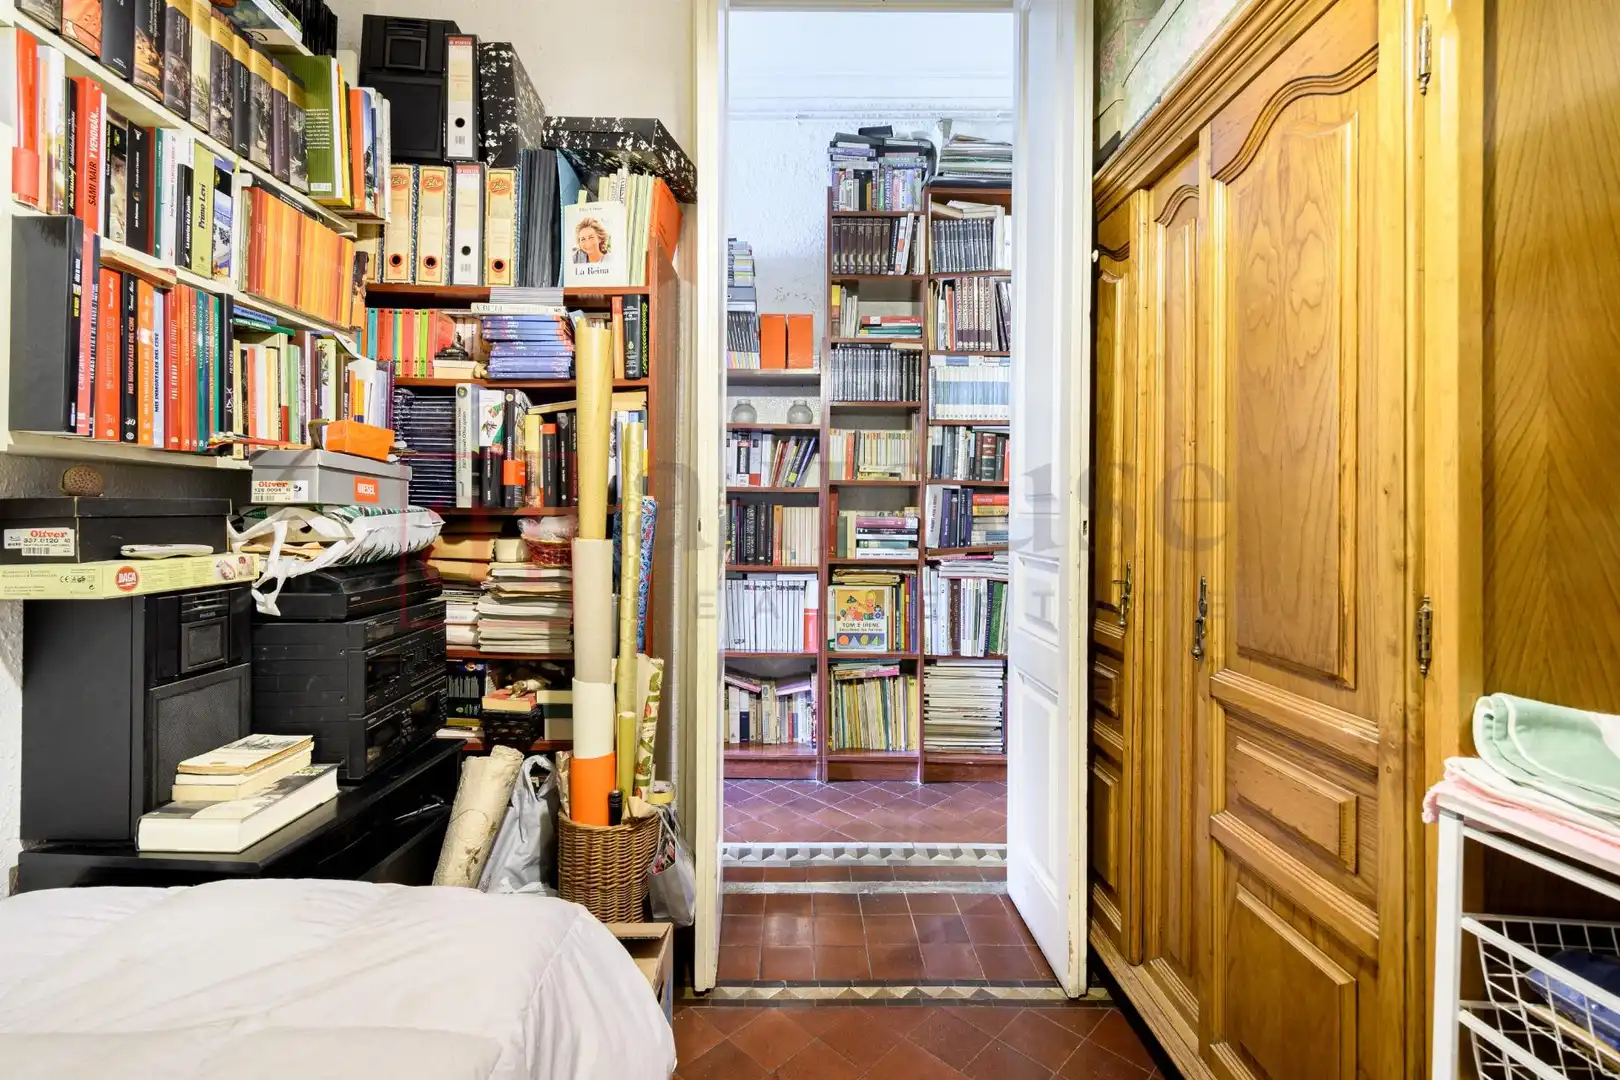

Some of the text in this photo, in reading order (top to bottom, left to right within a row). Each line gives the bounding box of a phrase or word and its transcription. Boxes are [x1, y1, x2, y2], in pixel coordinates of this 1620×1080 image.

[88, 185, 97, 206] SAMI
[198, 183, 206, 230] Primo Levi
[587, 266, 609, 275] Reina
[357, 484, 376, 494] DIESEL
[30, 529, 66, 538] Oliver
